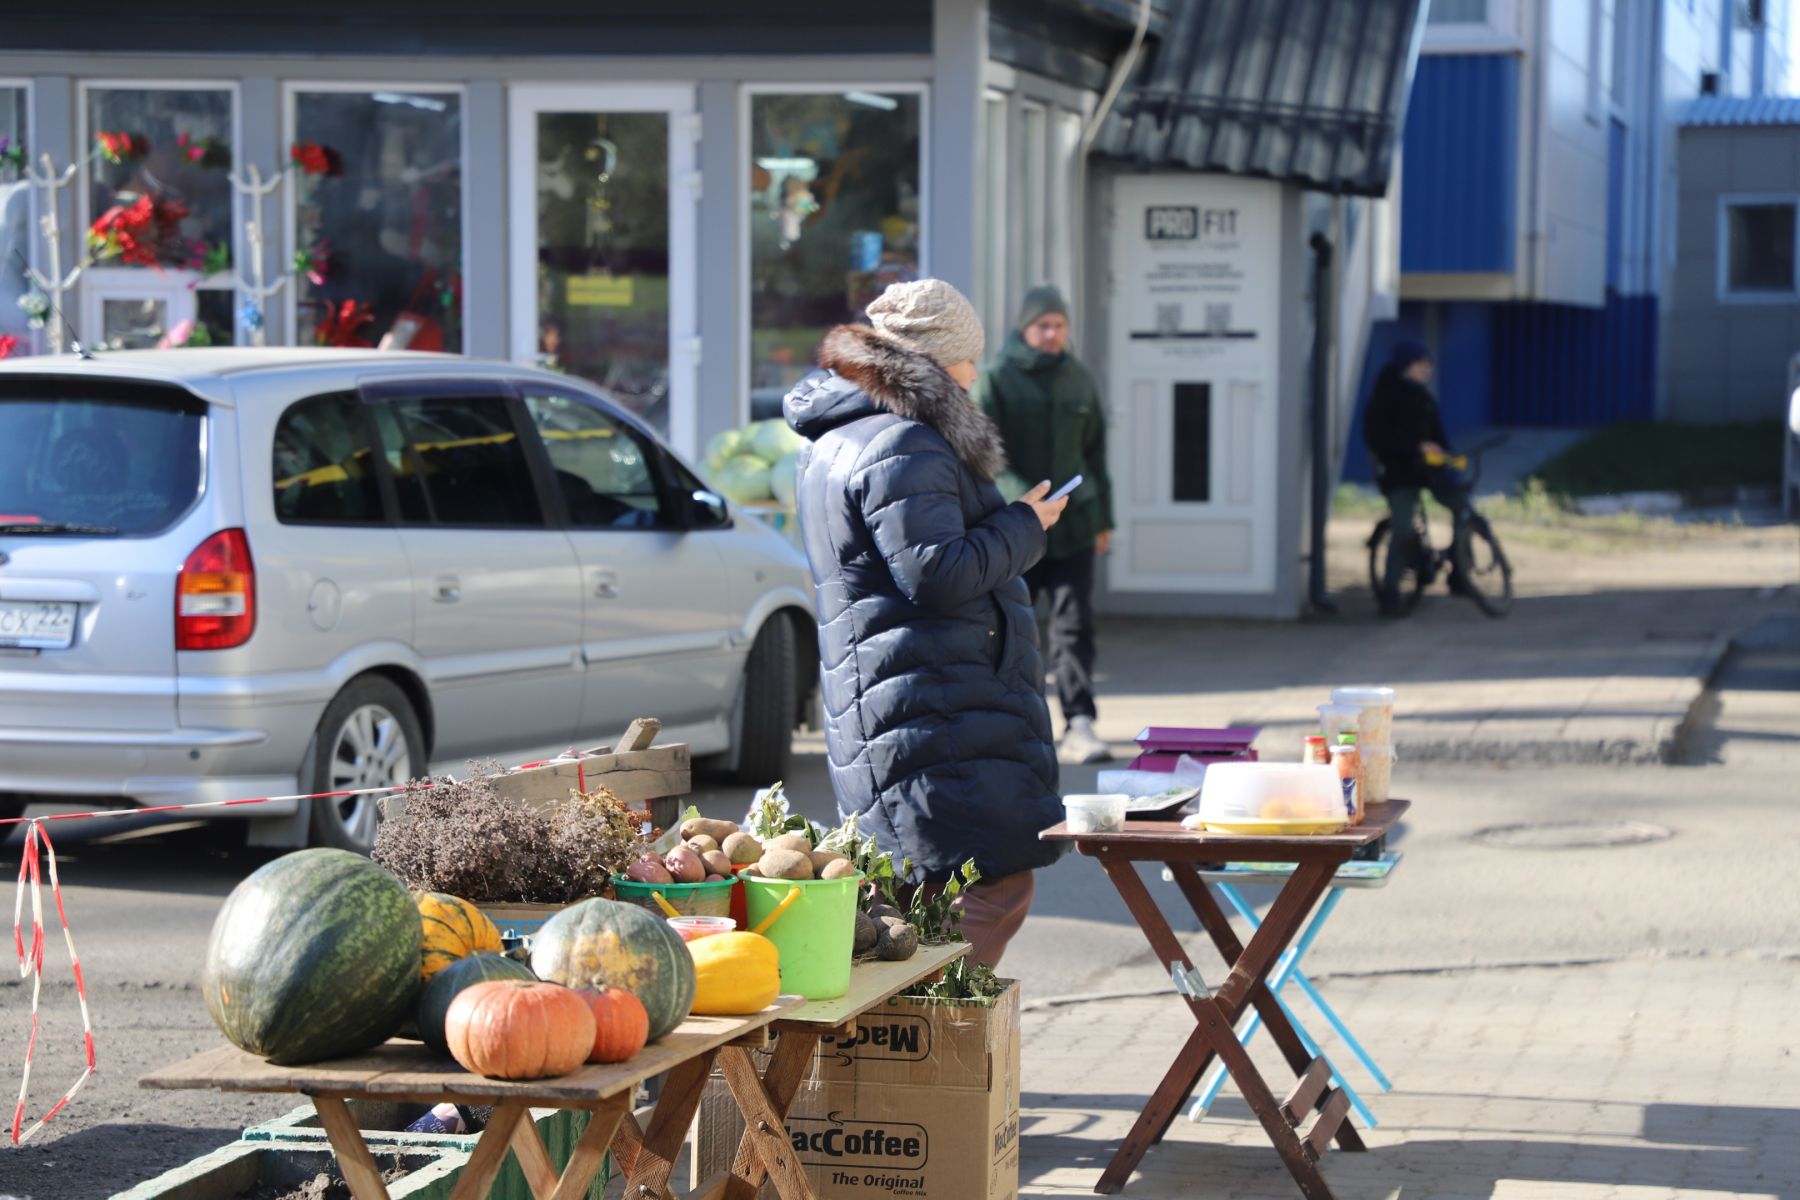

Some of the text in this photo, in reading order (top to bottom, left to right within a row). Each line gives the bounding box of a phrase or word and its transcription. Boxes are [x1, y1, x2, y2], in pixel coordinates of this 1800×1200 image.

[1148, 209, 1238, 238] PRO FIT
[39, 606, 62, 625] 22
[832, 1172, 925, 1191] The Original
